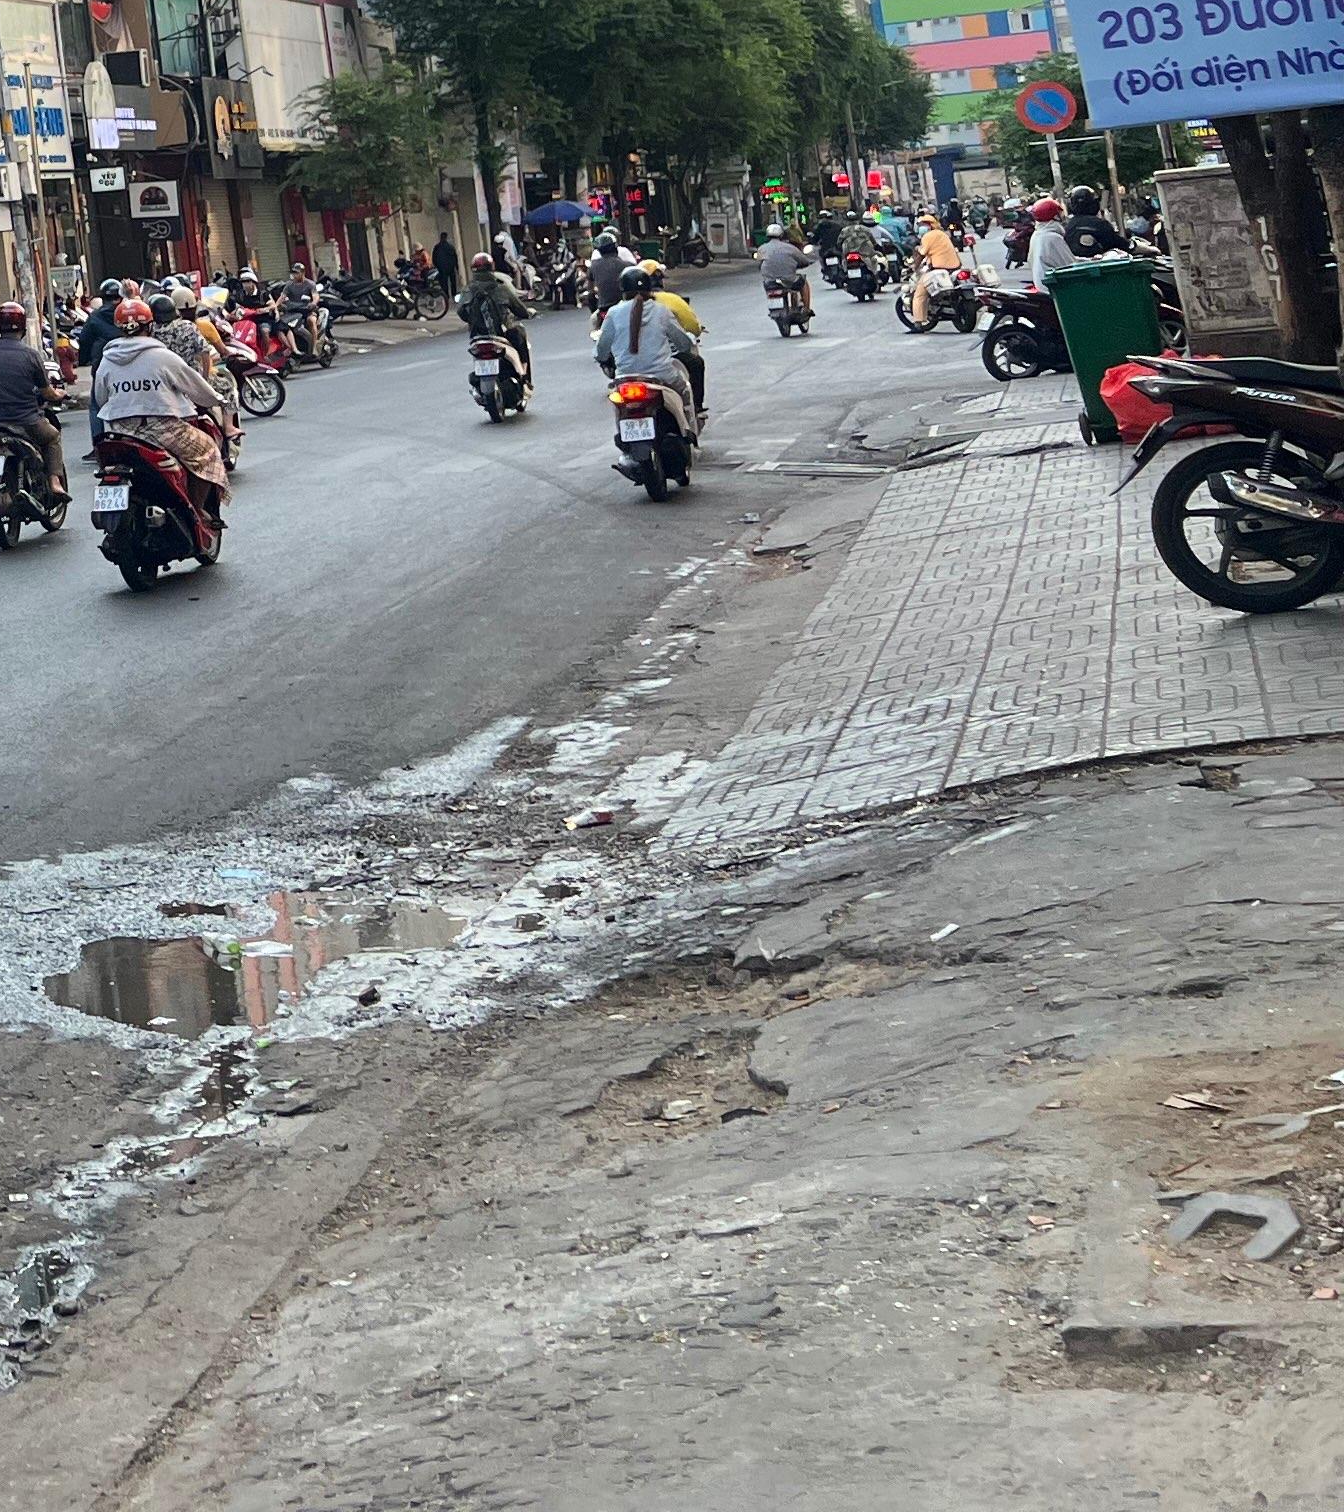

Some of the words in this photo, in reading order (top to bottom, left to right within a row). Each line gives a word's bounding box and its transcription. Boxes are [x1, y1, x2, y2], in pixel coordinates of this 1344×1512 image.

[1097, 2, 1184, 50] 203
[1114, 56, 1184, 106] (Đối
[1191, 54, 1272, 92] diện
[113, 379, 161, 394] YOUSY
